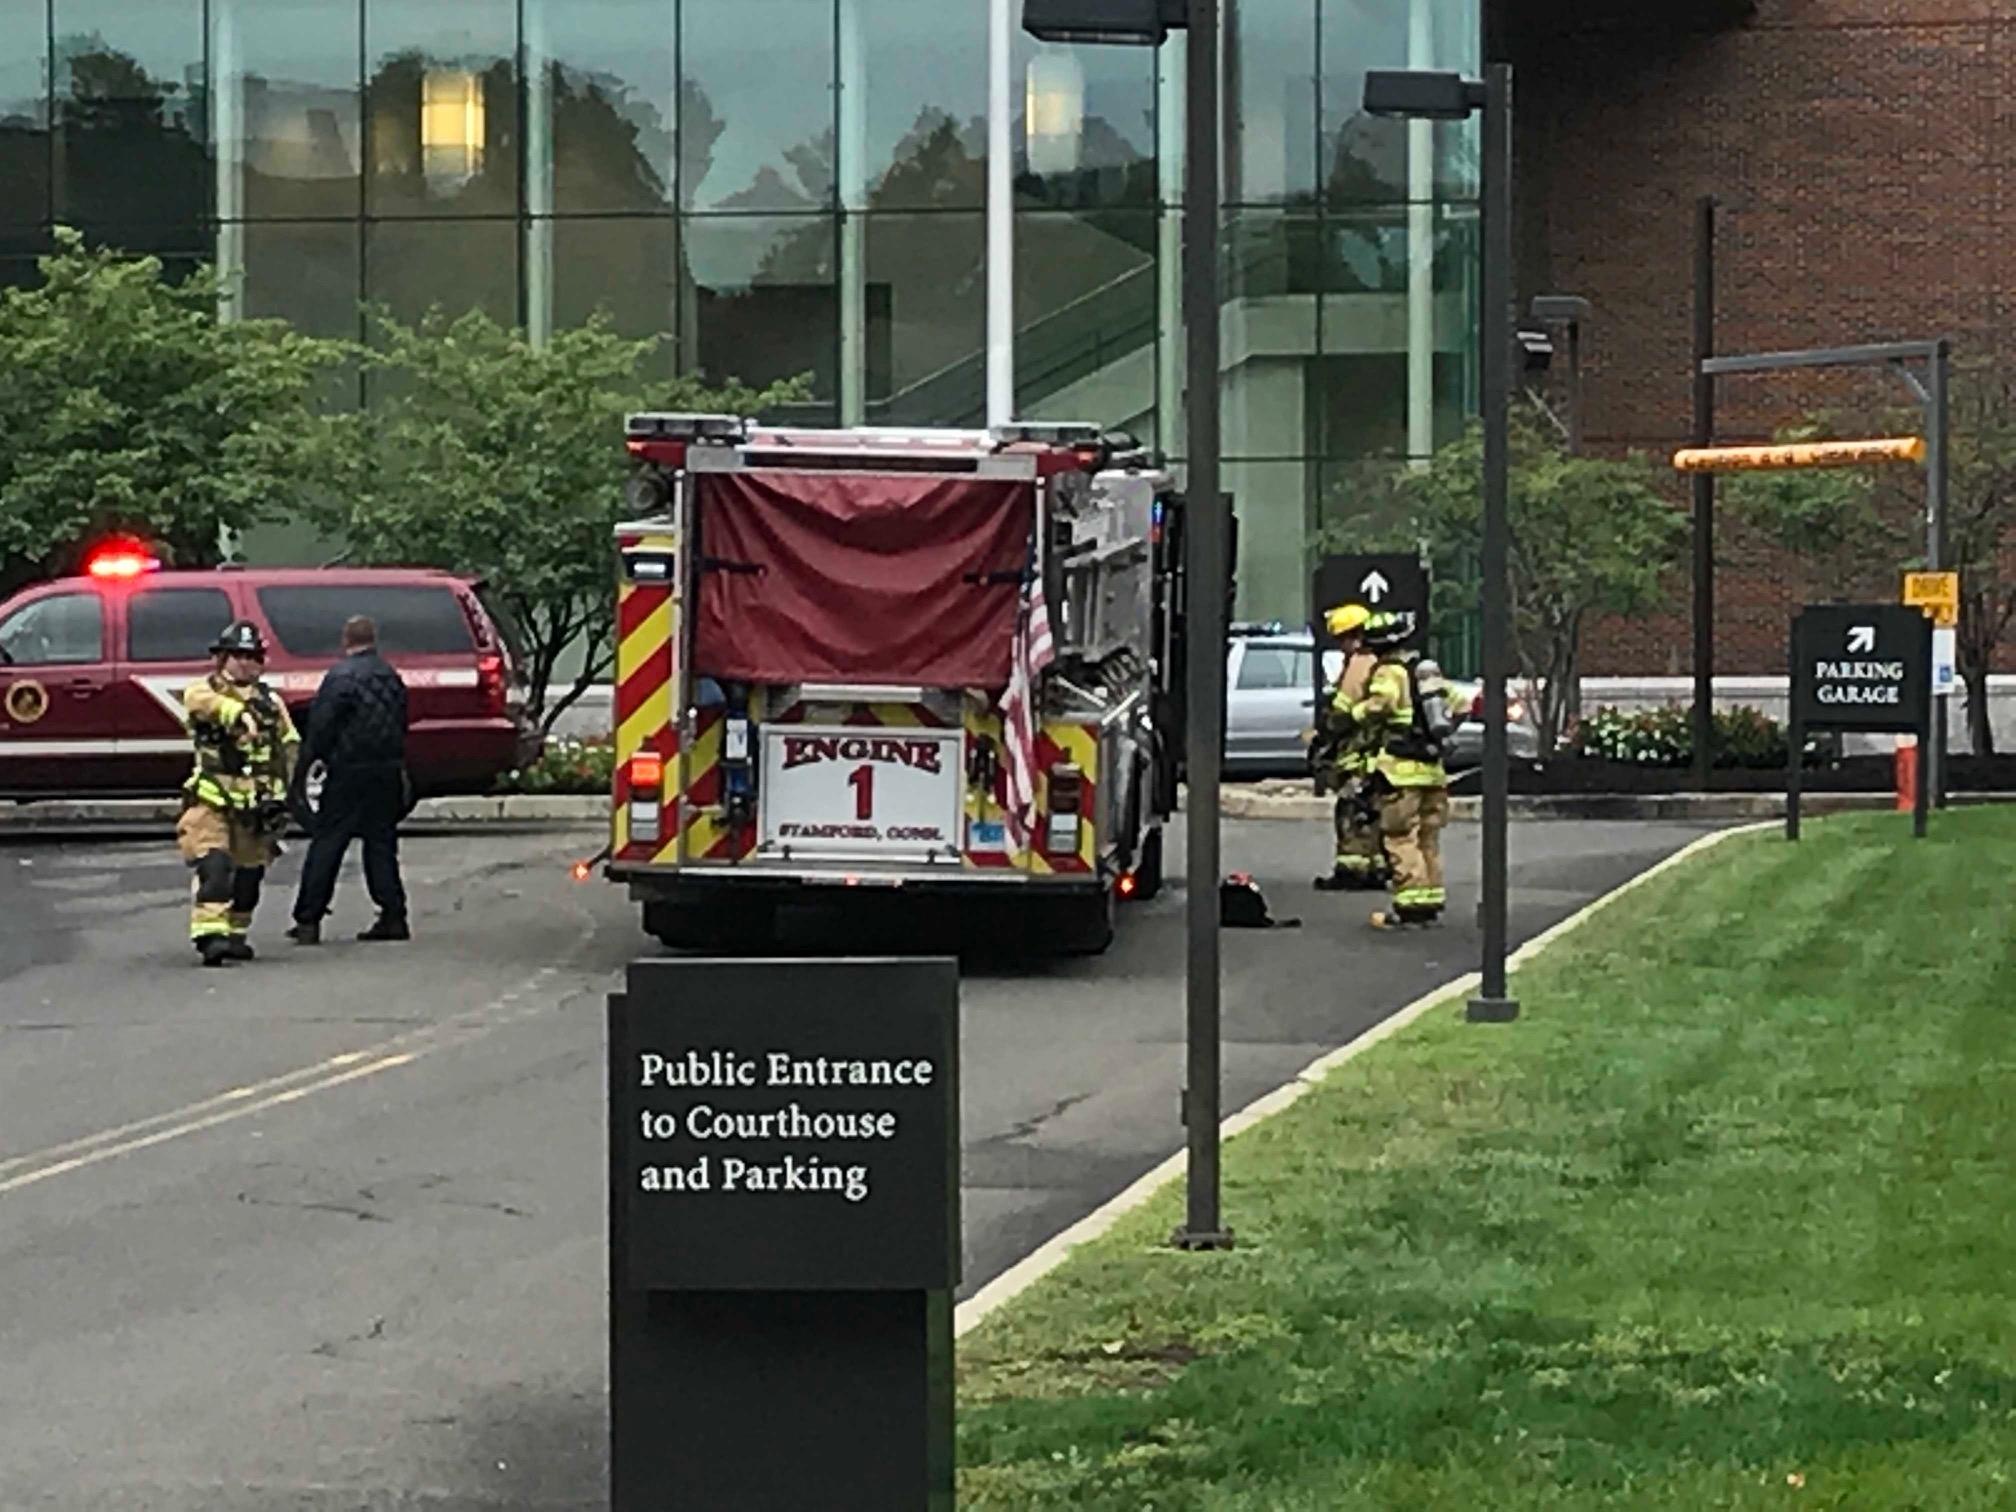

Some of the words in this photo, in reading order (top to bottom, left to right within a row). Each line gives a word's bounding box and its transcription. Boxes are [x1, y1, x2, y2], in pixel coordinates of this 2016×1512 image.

[1815, 661, 1904, 680] PARKING
[1816, 684, 1899, 703] GARAGE
[782, 737, 941, 774] ENGINE
[848, 764, 874, 821] 1
[640, 1050, 756, 1086] Public
[766, 1052, 933, 1086] Entrance
[640, 1109, 676, 1138] to
[686, 1102, 896, 1138] Courthouse
[640, 1156, 710, 1190] and
[721, 1155, 868, 1200] Parking
